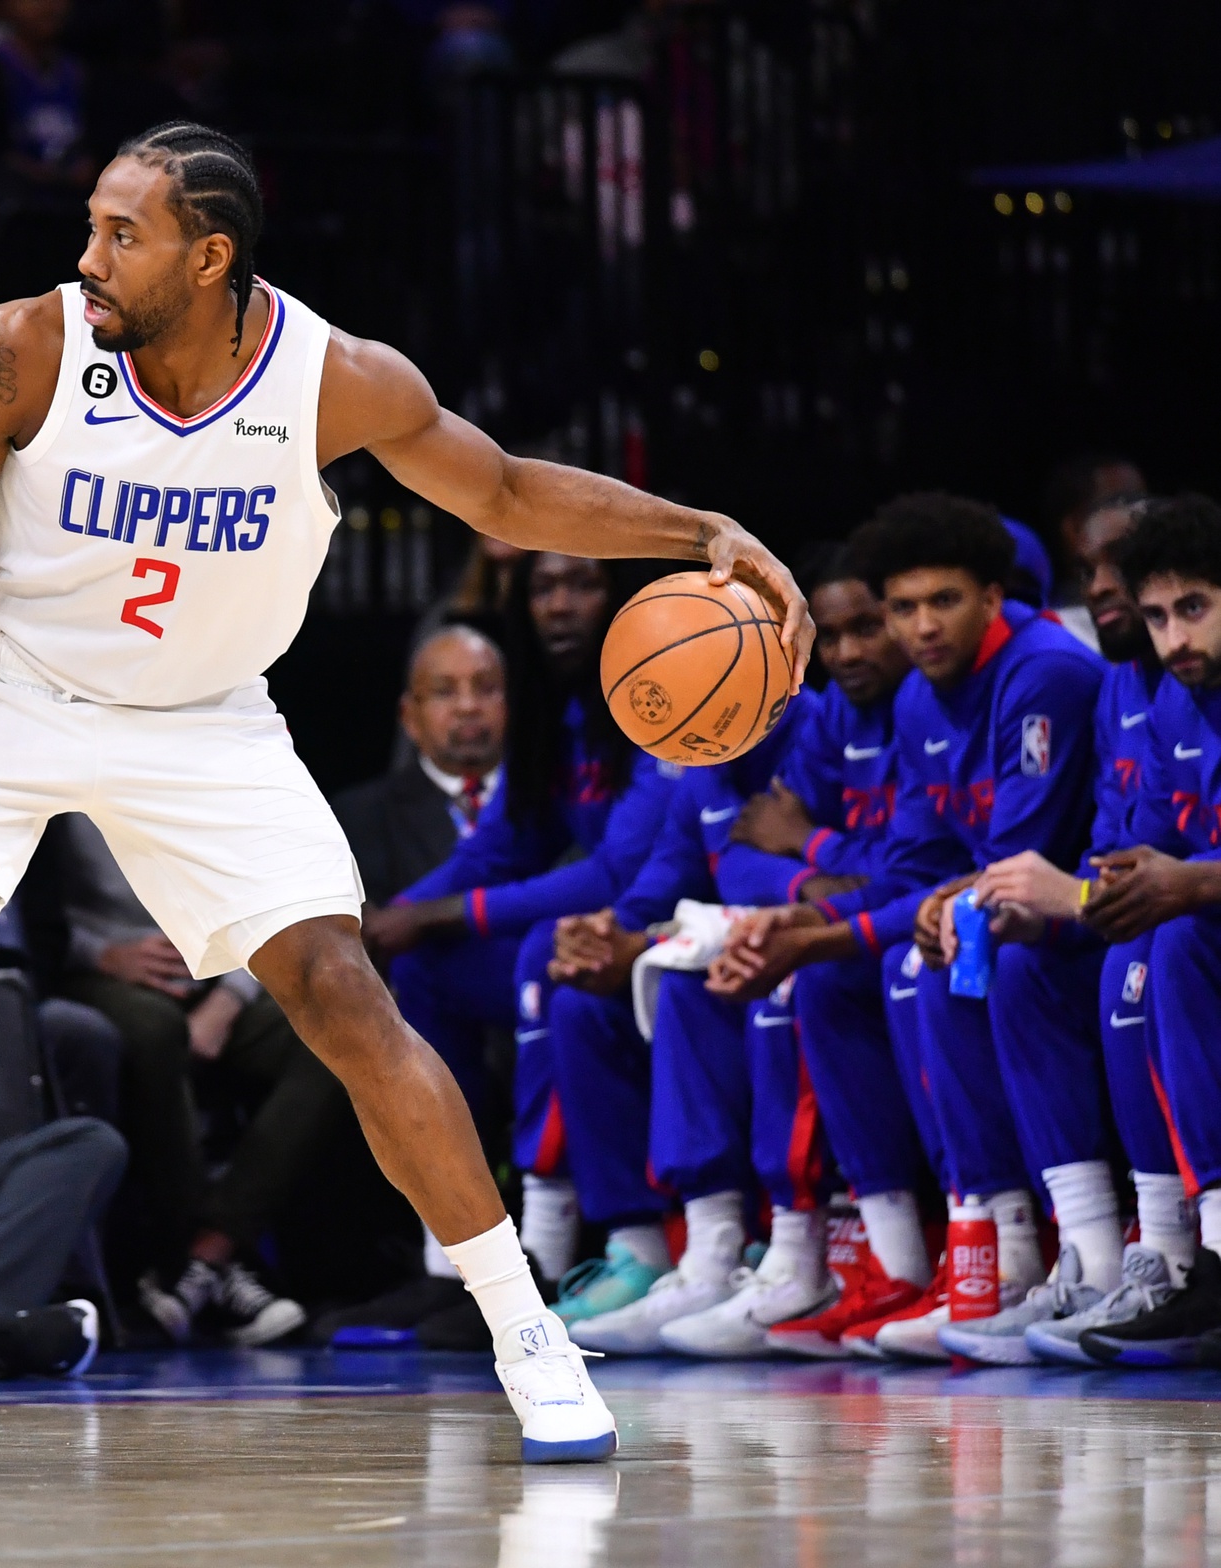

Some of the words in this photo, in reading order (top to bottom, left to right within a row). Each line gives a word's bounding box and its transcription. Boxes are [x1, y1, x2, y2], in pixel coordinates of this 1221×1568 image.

[89, 368, 110, 395] 6
[234, 417, 289, 443] honey
[59, 468, 276, 552] CLIPPERS
[121, 558, 181, 639] 2
[953, 1245, 996, 1265] BIO
